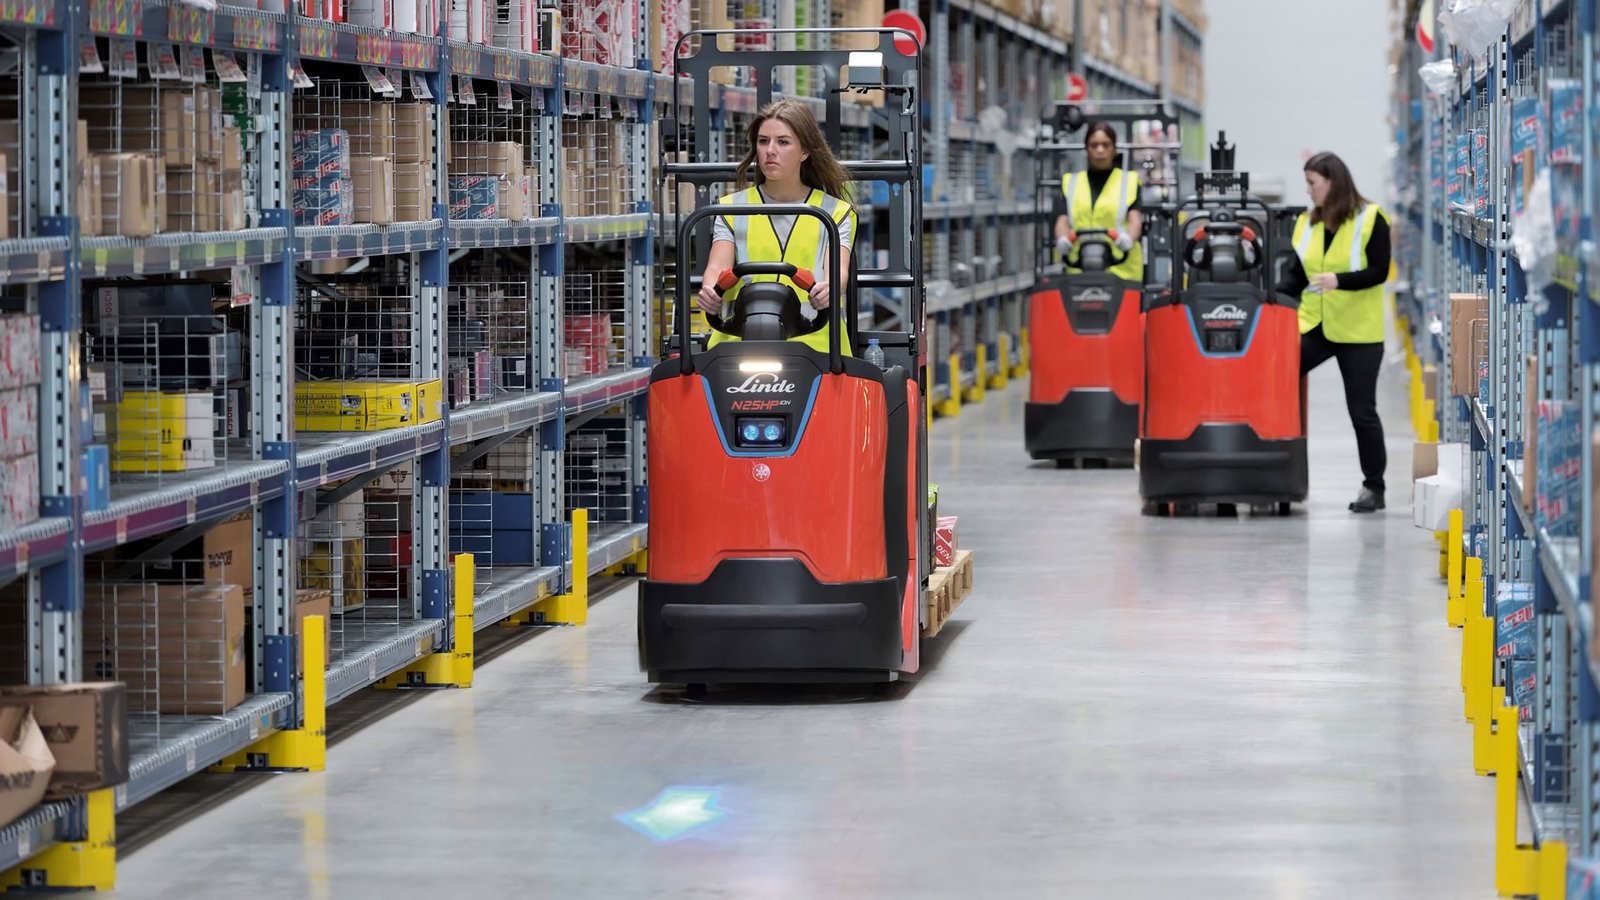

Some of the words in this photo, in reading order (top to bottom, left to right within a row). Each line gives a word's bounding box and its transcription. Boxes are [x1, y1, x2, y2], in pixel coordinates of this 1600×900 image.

[1201, 304, 1248, 319] Linde
[726, 372, 795, 393] Linde
[731, 400, 779, 411] N25HP
